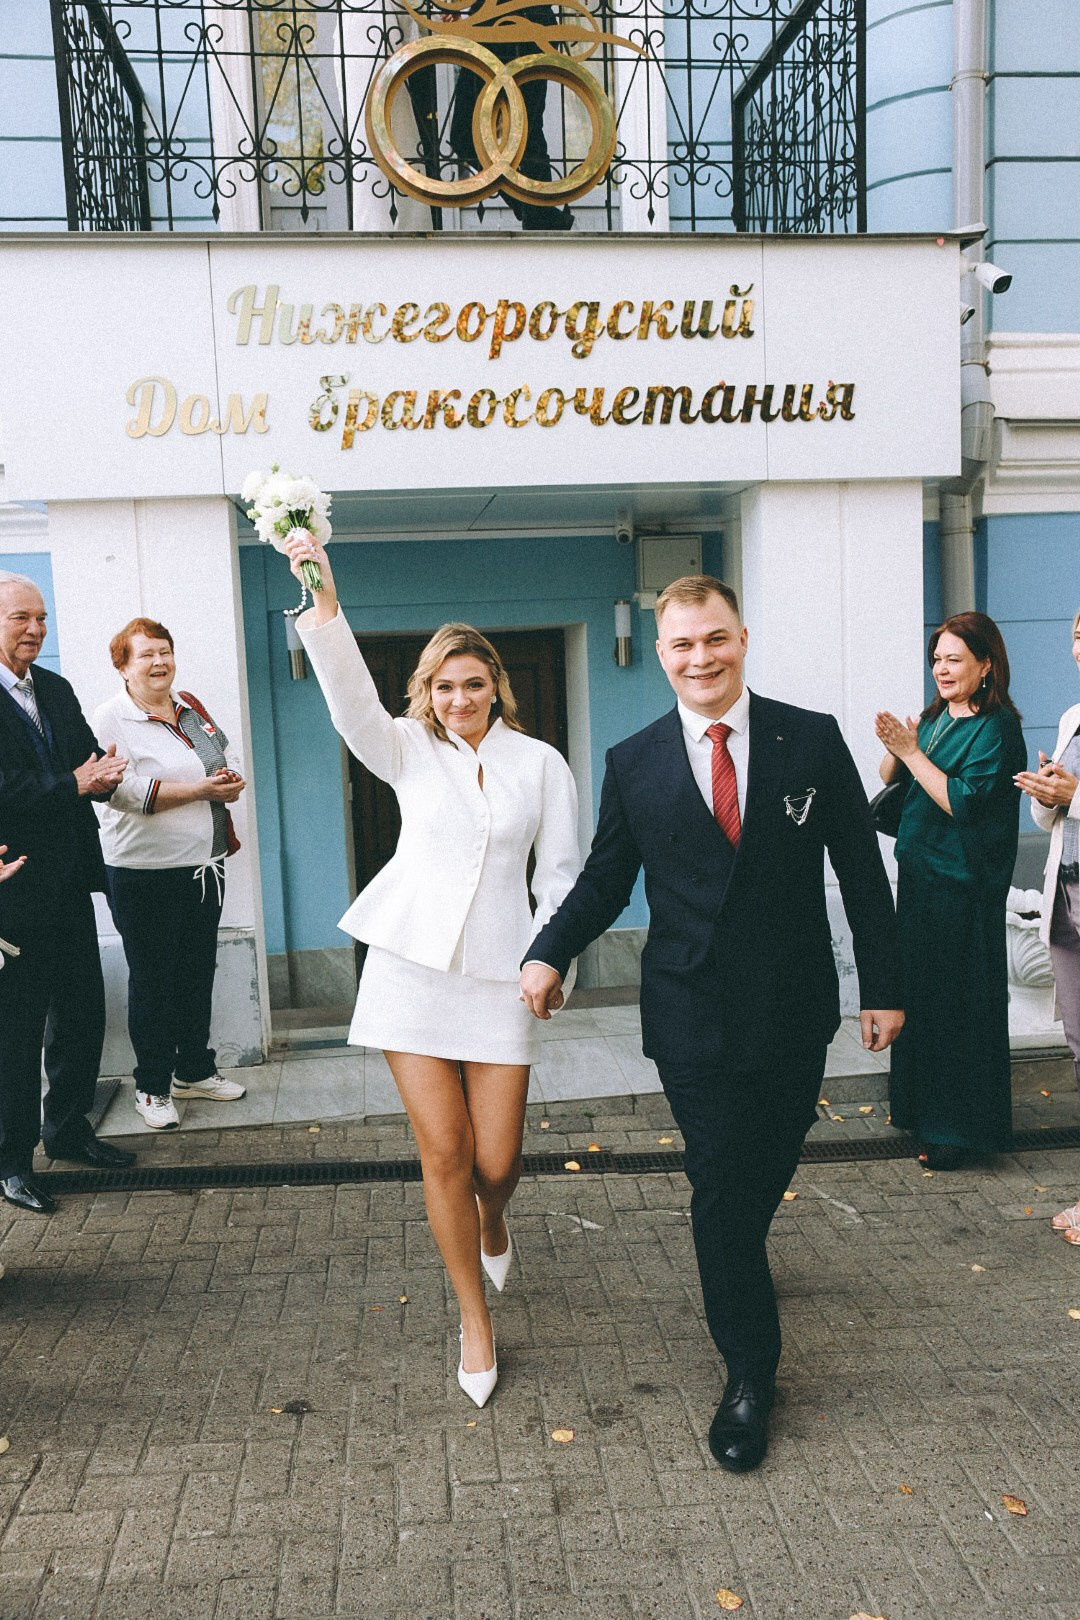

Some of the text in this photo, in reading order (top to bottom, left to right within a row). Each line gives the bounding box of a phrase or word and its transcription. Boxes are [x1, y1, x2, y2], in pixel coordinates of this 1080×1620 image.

[227, 284, 755, 360] Нижегородский
[126, 373, 856, 450] Дом бракосочетания
